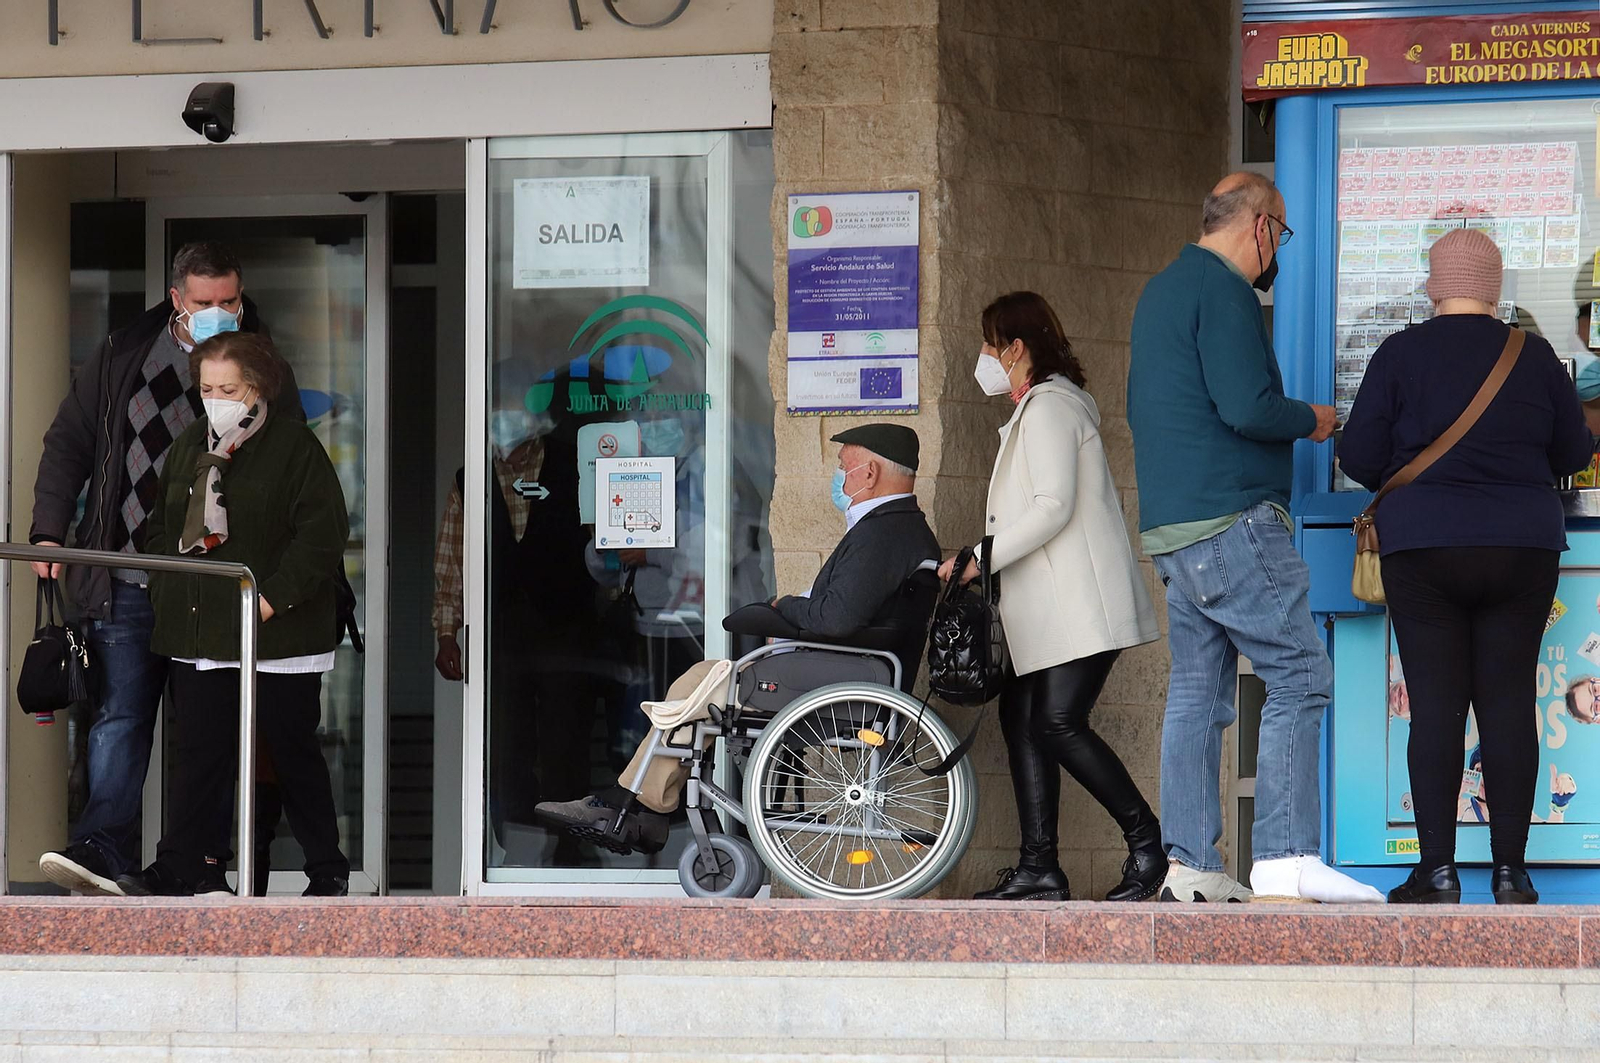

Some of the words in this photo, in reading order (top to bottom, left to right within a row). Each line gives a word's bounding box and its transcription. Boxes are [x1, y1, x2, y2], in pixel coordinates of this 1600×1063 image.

[1490, 23, 1529, 37] CADA
[1531, 21, 1591, 35] VIERNES
[1278, 33, 1342, 61] EURO
[1450, 42, 1477, 61] EL
[1480, 37, 1600, 60] MEGASORT
[1256, 58, 1362, 88] JACKPOT
[1425, 63, 1527, 84] EUROPEO
[1531, 62, 1559, 80] DE
[1564, 61, 1592, 79] LA
[538, 222, 624, 244] SALIDA
[811, 264, 837, 272] Servicio
[838, 263, 865, 271] Andaluz
[866, 262, 875, 270] de
[876, 262, 895, 270] Salud
[826, 255, 853, 263] Organismo
[848, 278, 869, 286] Proyecto
[835, 312, 870, 321] 31/05/2011
[832, 370, 857, 378] Europea
[566, 393, 609, 412] JUNTA
[616, 393, 633, 411] DE
[1546, 643, 1568, 662] TÚ,
[1535, 700, 1568, 749] S
